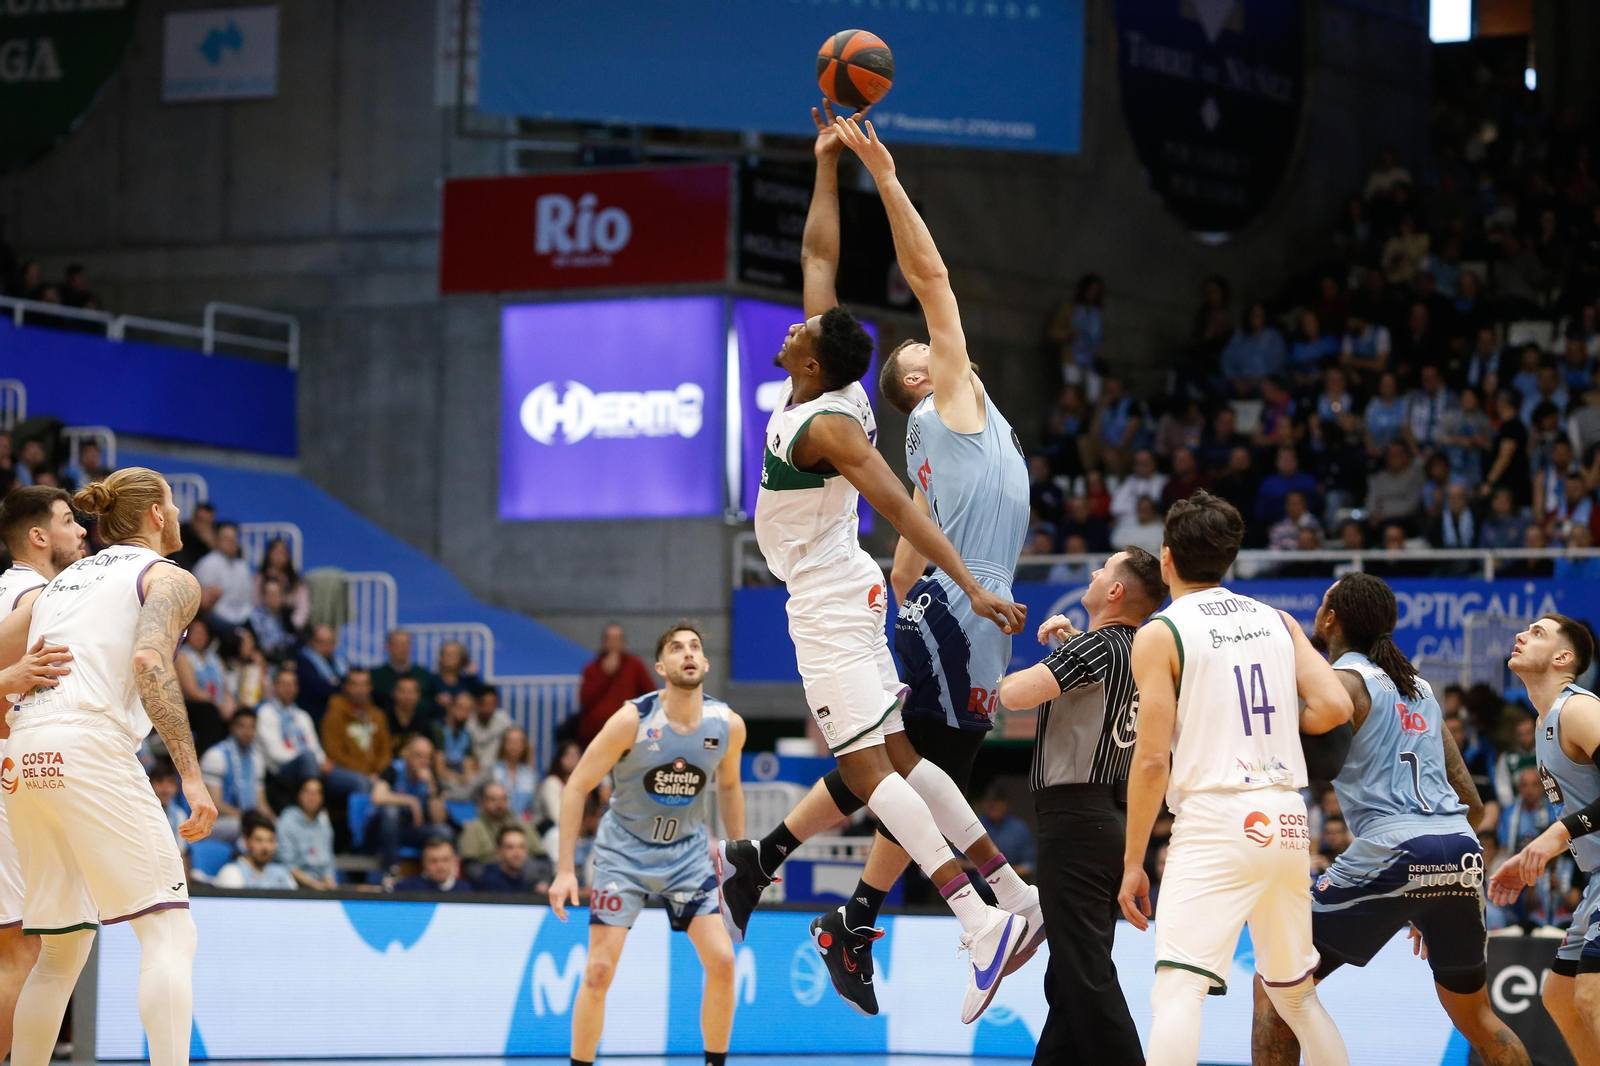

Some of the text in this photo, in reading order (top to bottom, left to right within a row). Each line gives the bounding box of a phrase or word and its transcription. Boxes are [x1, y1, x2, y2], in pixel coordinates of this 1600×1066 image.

[534, 191, 633, 256] Río
[1234, 663, 1276, 737] 14
[1125, 700, 1139, 733] 5
[22, 752, 65, 766] COSTA
[22, 766, 65, 779] DEL SOL
[654, 770, 701, 784] Estrella
[25, 779, 67, 790] MÁLAGA
[654, 781, 697, 796] Galicia
[1279, 813, 1308, 826] COST
[651, 814, 680, 844] 10
[1280, 828, 1300, 838] DEL
[1408, 863, 1459, 873] DEPUTACIÓN
[1408, 872, 1458, 887] DE LUGO
[1404, 890, 1481, 900] VICEPRESIDENC
